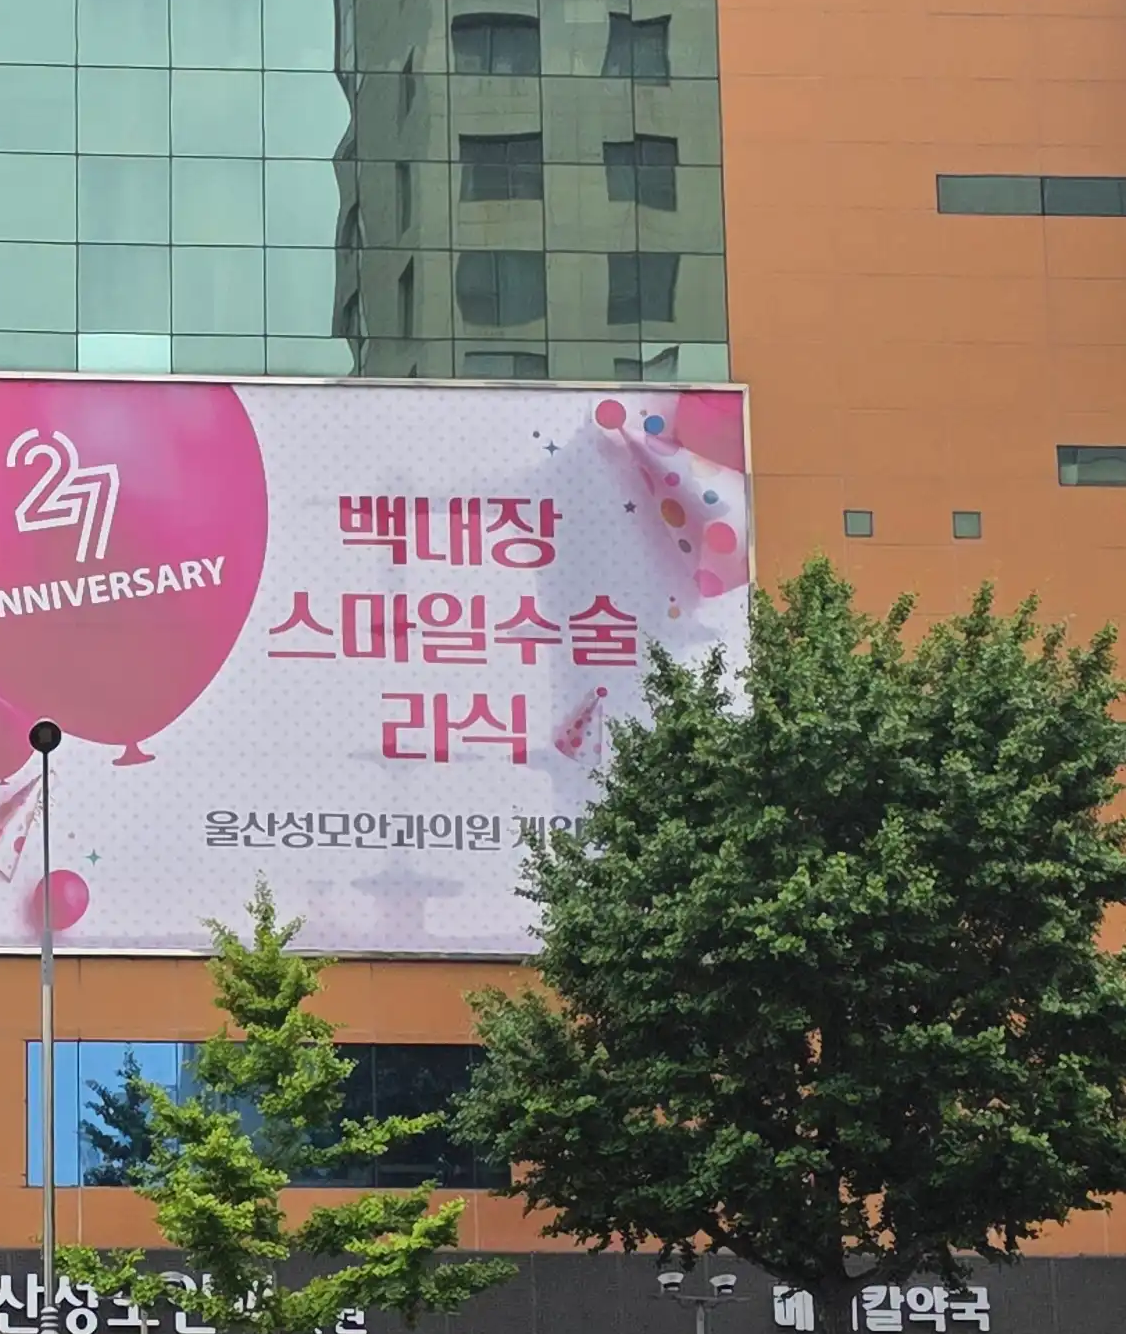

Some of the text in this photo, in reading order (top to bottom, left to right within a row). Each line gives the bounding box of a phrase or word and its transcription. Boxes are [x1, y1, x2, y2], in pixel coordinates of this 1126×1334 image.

[6, 427, 120, 563] 27
[338, 494, 564, 569] 백내장
[267, 591, 639, 667] 스마일수술
[381, 692, 529, 766] 라식
[204, 809, 501, 852] 울산성모안과의원
[772, 1285, 991, 1333] 메칼약국
